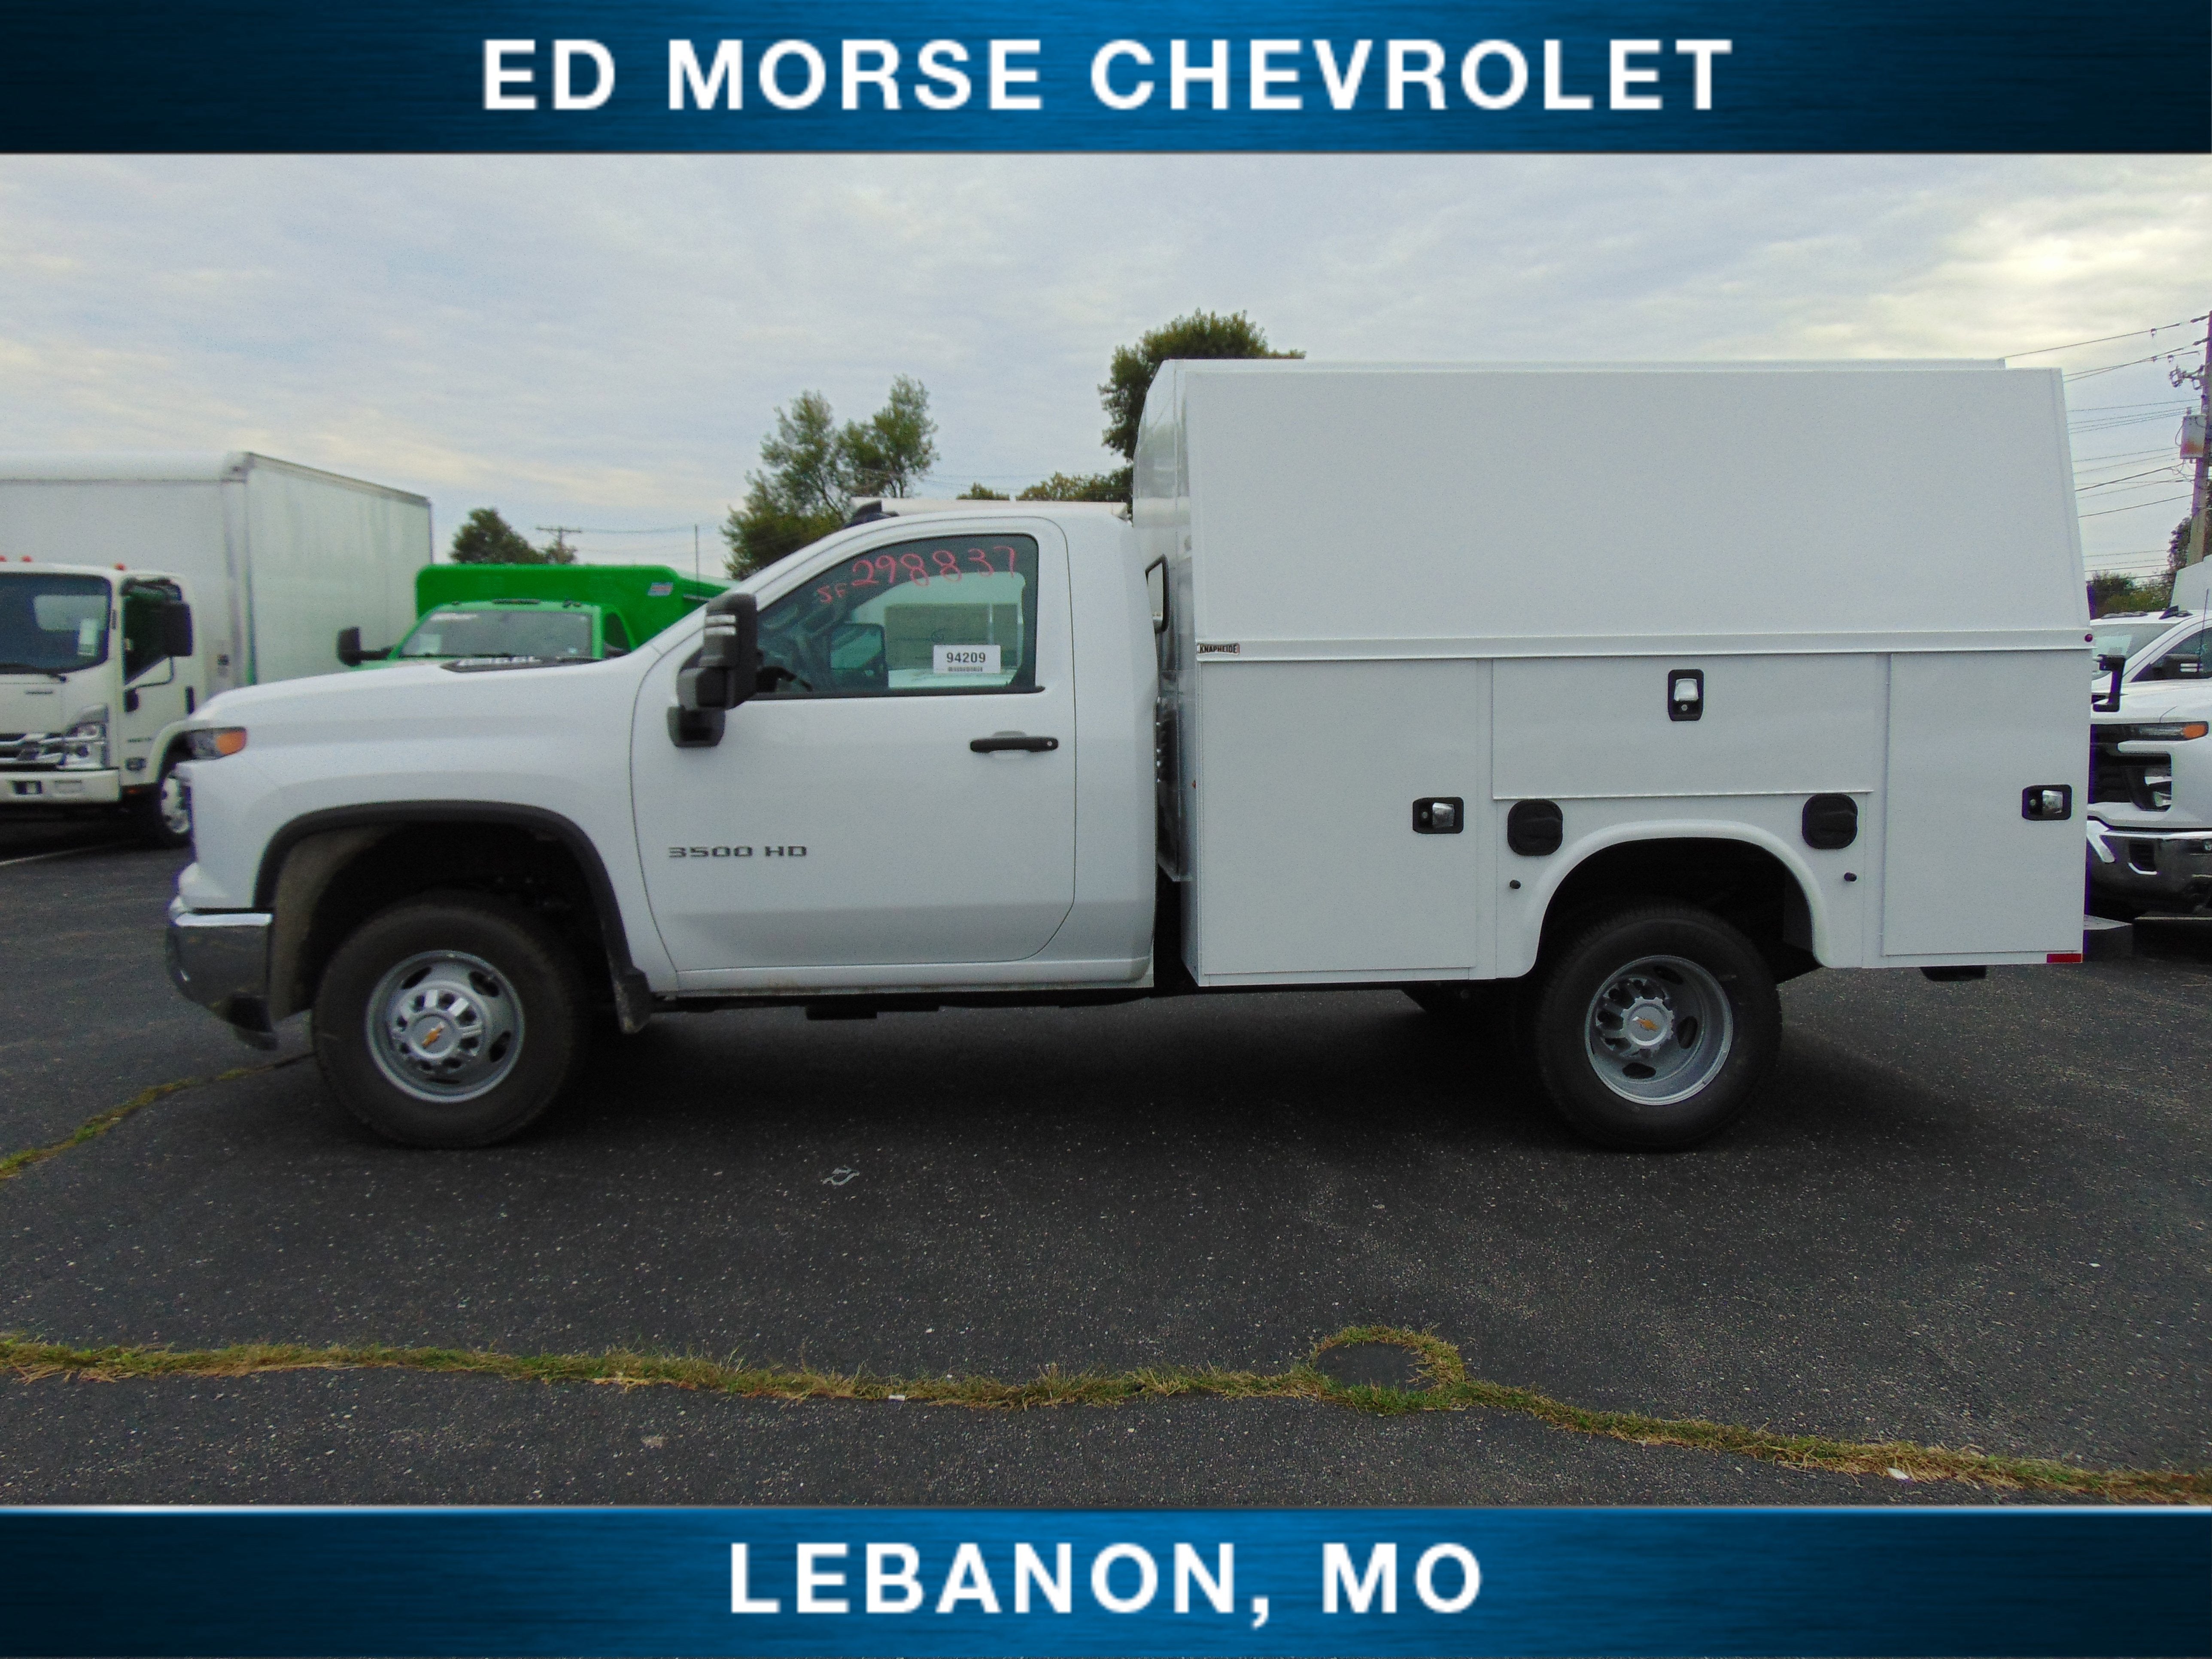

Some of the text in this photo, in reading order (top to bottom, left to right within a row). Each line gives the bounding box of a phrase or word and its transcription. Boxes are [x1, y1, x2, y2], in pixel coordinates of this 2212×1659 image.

[851, 545, 1016, 587] 298837
[1200, 644, 1237, 653] KNAPHEIDE
[946, 652, 986, 663] 94209
[668, 845, 808, 858] 3500 HD
